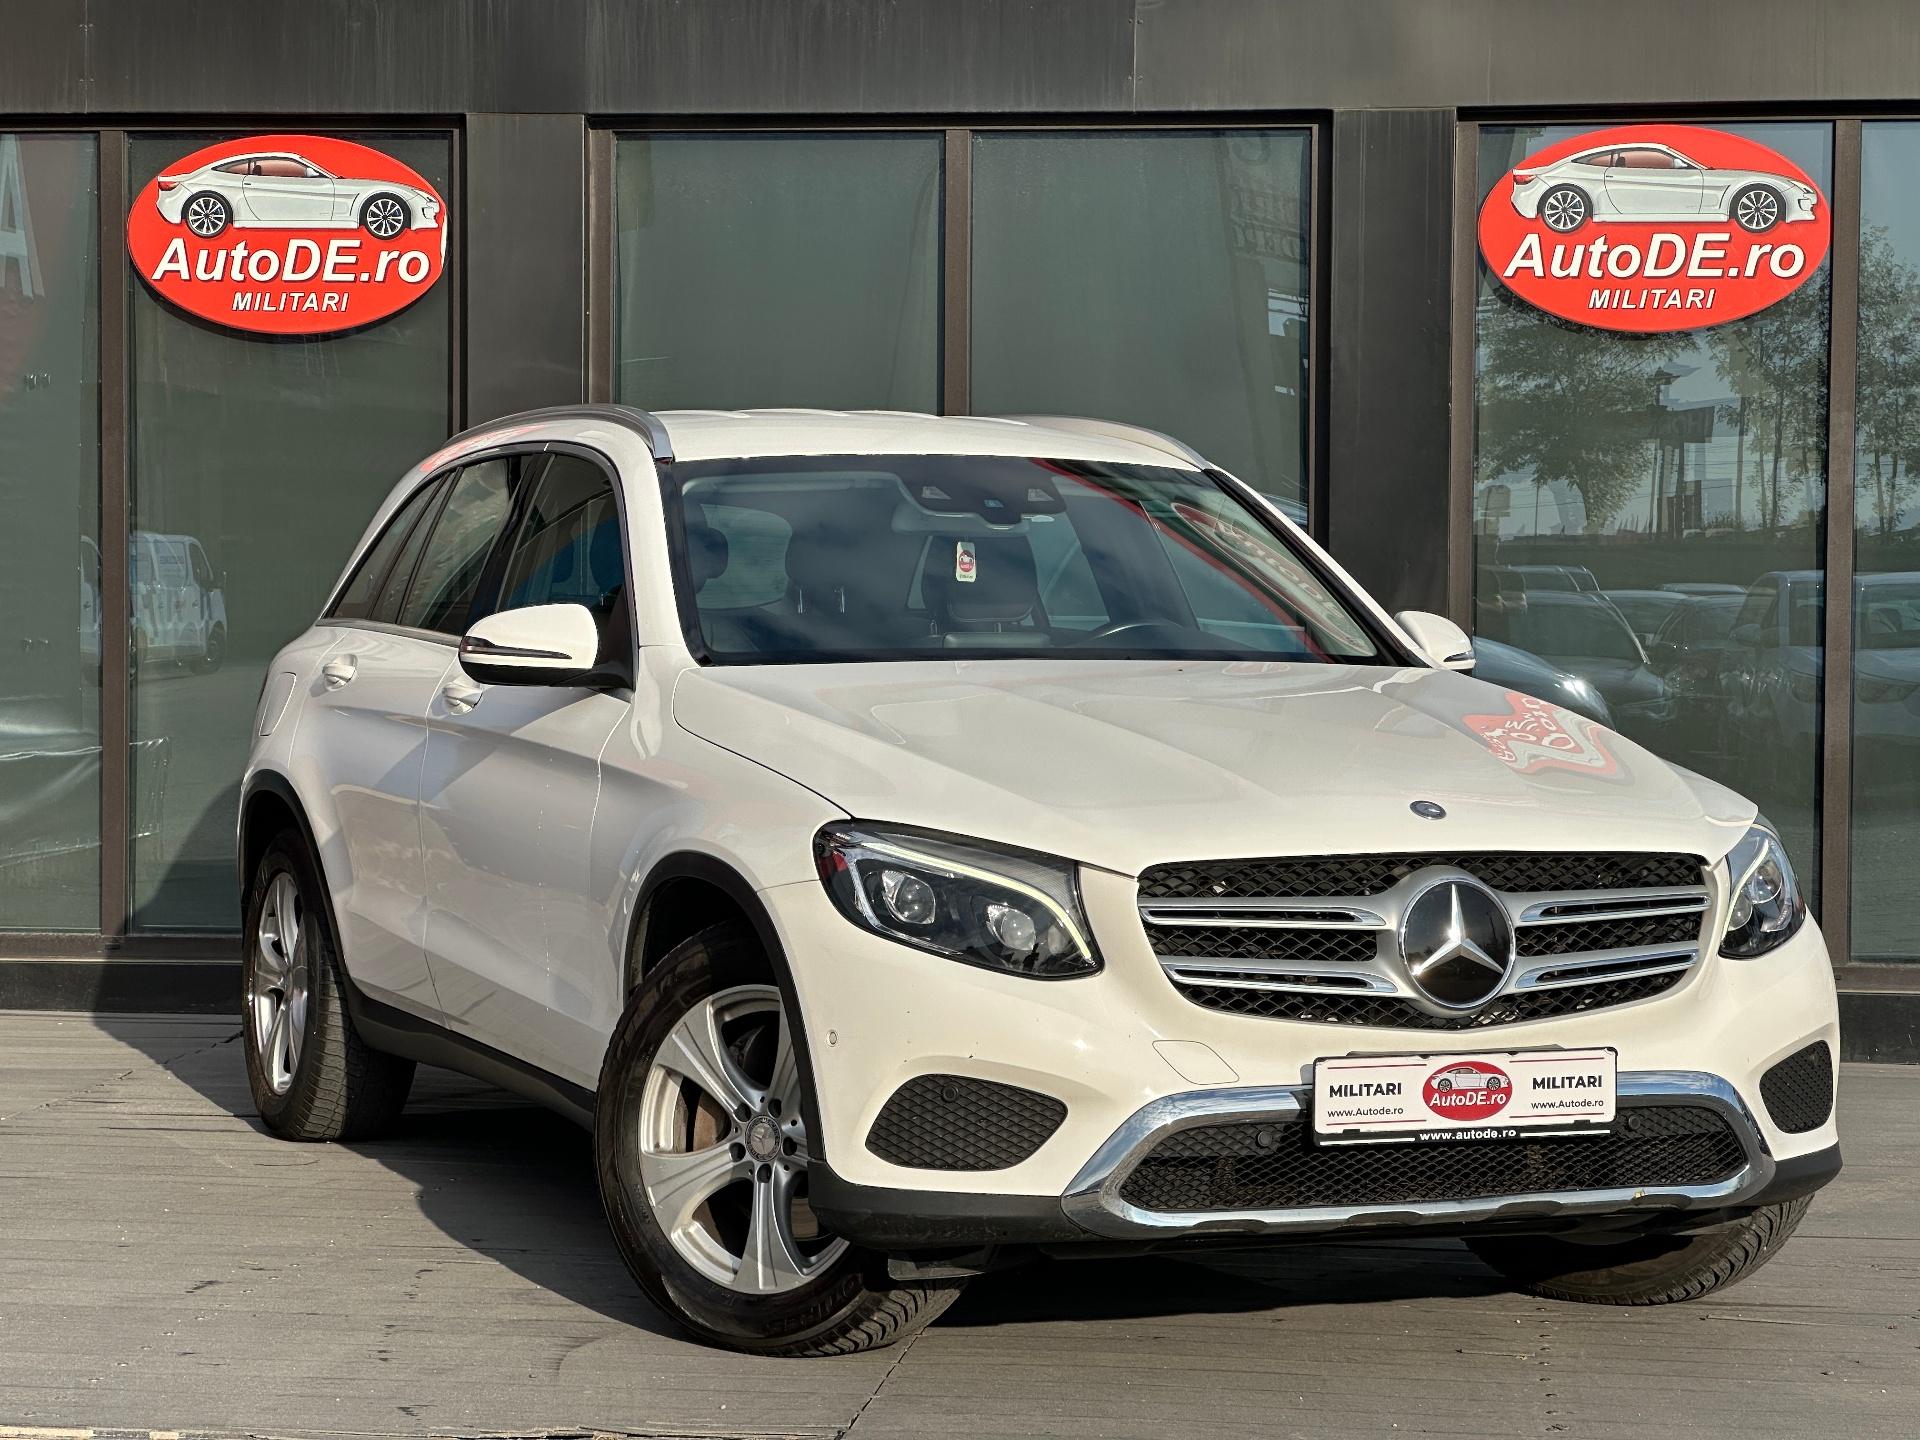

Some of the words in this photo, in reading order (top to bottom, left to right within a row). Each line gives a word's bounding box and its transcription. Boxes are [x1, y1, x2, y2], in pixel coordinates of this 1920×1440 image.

[151, 238, 431, 284] AutoDE.ro
[1503, 232, 1806, 279] AutoDE.ro
[231, 292, 349, 312] MILITARI
[1588, 288, 1716, 310] MILITARI
[1328, 1082, 1402, 1098] MILITARI
[1532, 1075, 1603, 1090] MILITARI
[1429, 1090, 1507, 1107] AutoDE.ro
[1530, 1098, 1604, 1110] www.Autode.ro
[1327, 1106, 1404, 1118] www.Autode.ro
[1419, 1127, 1517, 1141] www.autode.ro
